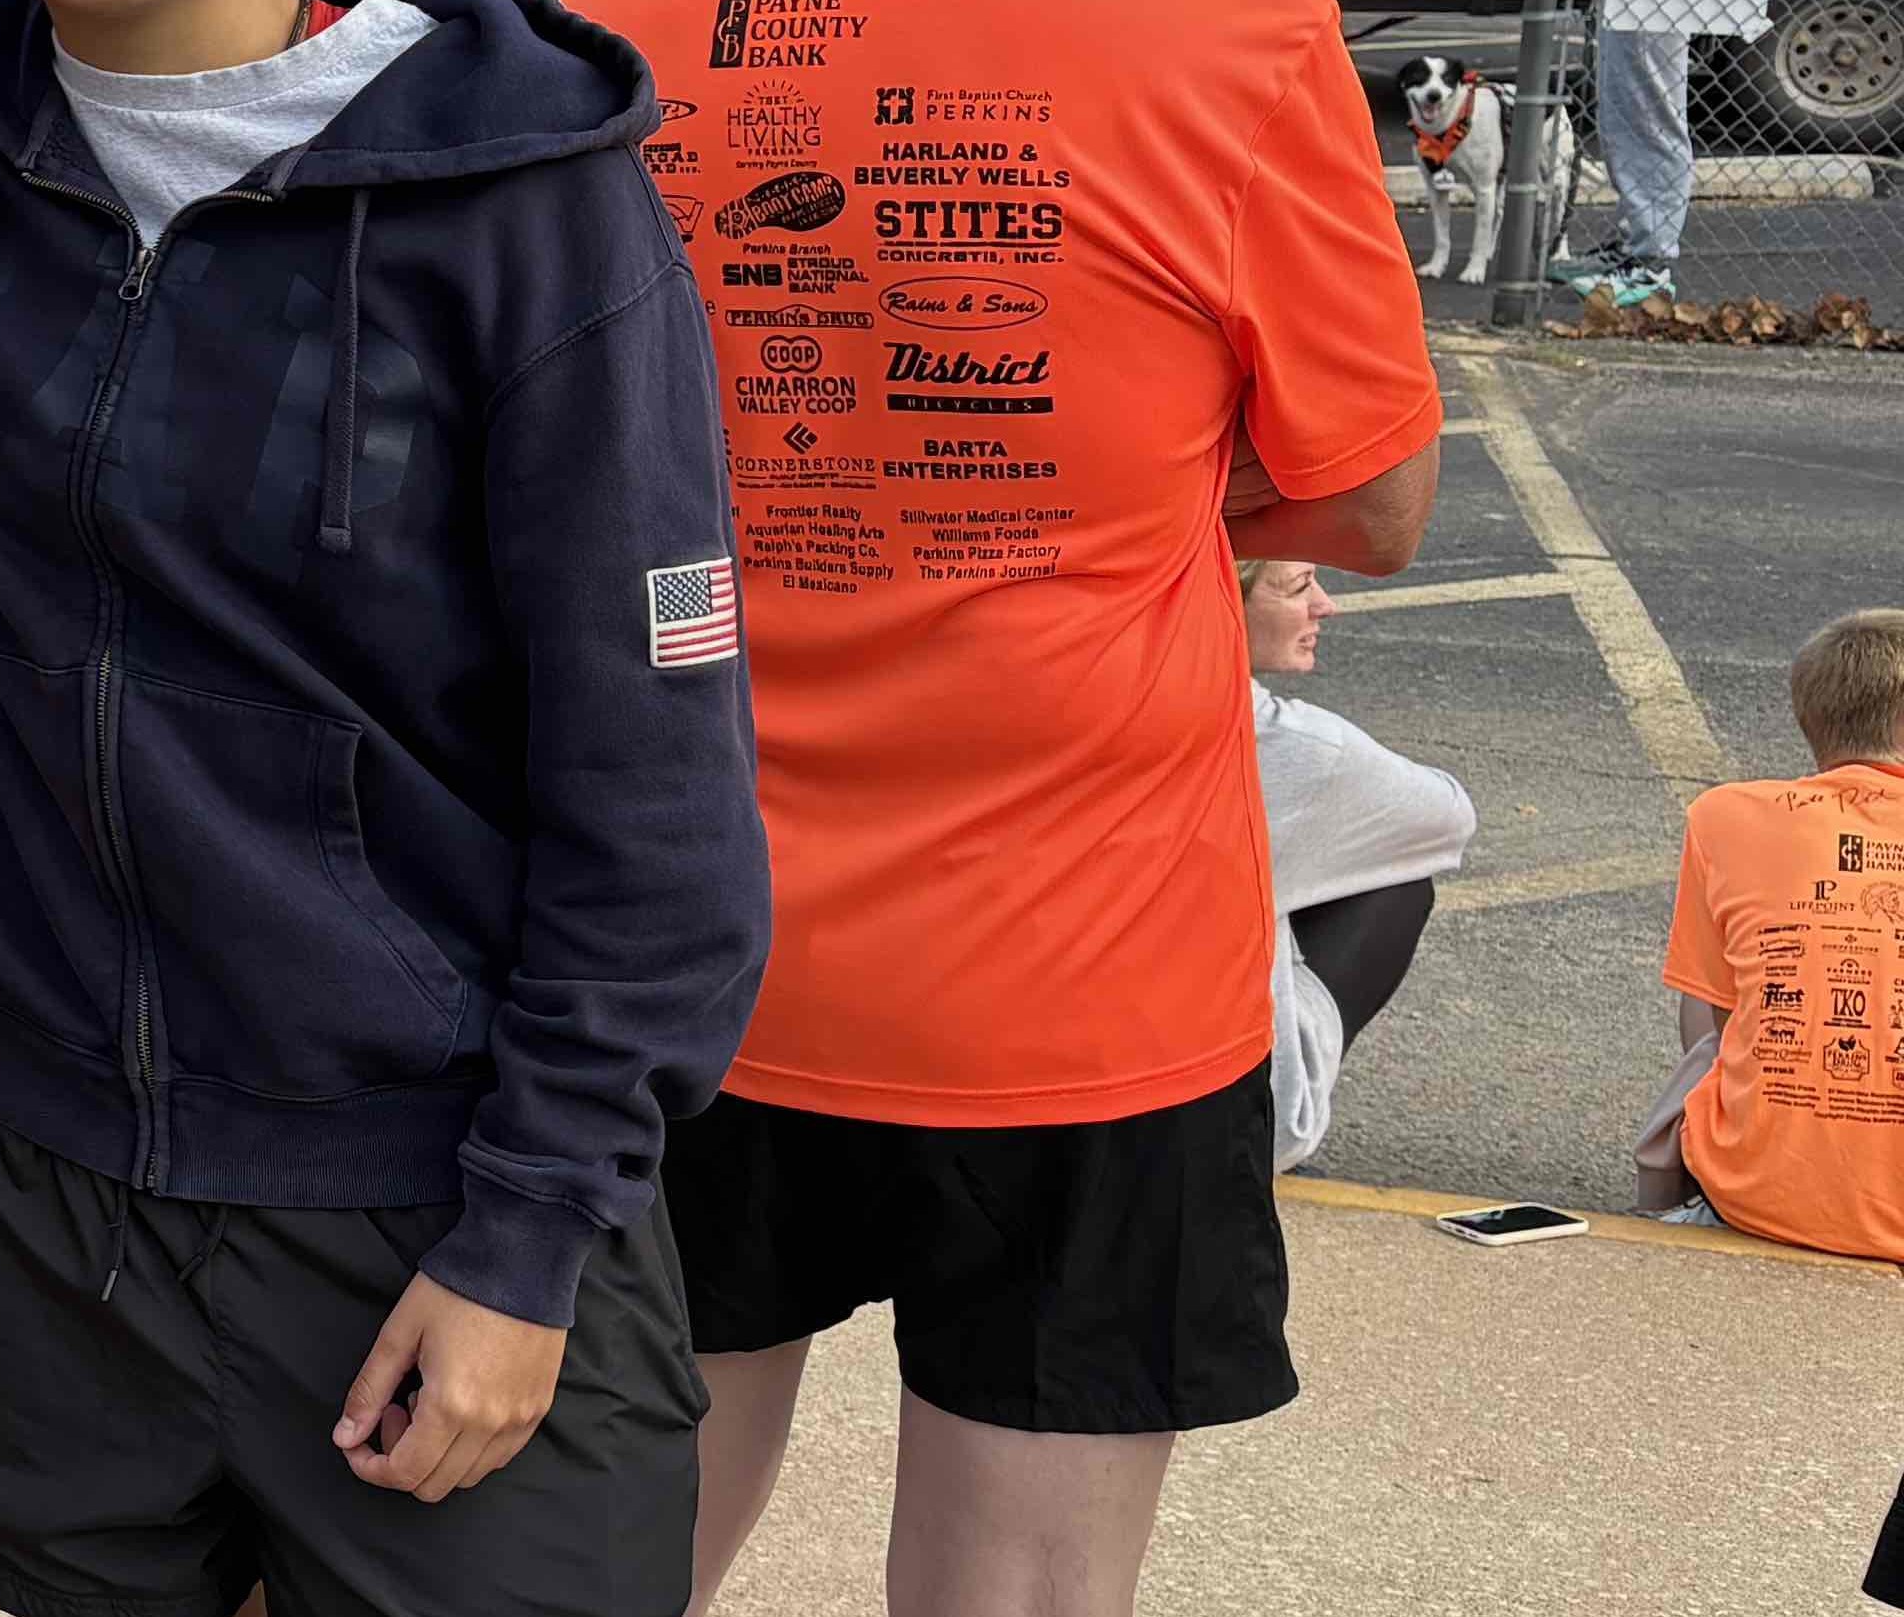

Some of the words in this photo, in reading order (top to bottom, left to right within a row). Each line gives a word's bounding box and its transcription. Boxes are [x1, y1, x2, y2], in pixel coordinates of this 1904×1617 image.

[750, 16, 868, 41] COUNTY
[748, 44, 828, 68] BANK
[926, 90, 954, 101] First
[958, 90, 1003, 103] Baptist
[1006, 90, 1053, 102] Church
[727, 106, 822, 126] HEALTHY
[926, 104, 1052, 122] PERKINS
[727, 127, 822, 148] LIVING
[882, 142, 1009, 161] HARLAND
[1018, 144, 1039, 161] &
[854, 167, 970, 185] BEVERLY
[976, 168, 1072, 188] WELLS
[874, 199, 1062, 240] STITES
[787, 257, 856, 270] STROUD
[1014, 251, 1065, 263] INC.
[722, 263, 784, 287] SNB
[787, 270, 870, 283] NATIONAL
[789, 283, 837, 294] BANK
[956, 293, 973, 313] &
[982, 293, 1040, 313] Sons
[766, 345, 816, 364] COOP
[882, 341, 1051, 385] District
[735, 376, 857, 397] CIMARRON
[736, 397, 801, 415] VALLEY
[805, 397, 857, 415] COOP
[907, 399, 1033, 412] BICYCLES
[923, 439, 1008, 458] BARTA
[735, 456, 876, 472] CORNERSTONE
[882, 461, 1059, 480] ENTERPRISES
[1024, 508, 1075, 522] Center
[858, 524, 885, 539] Arts
[932, 528, 991, 542] Williams
[994, 527, 1039, 540] Foods
[858, 543, 881, 558] Co.
[913, 546, 965, 561] Perkins
[967, 546, 1004, 560] Pizza
[1007, 544, 1062, 561] Factory
[919, 564, 944, 580] The
[946, 565, 996, 580] Perkins
[1000, 562, 1057, 579] Journal
[1866, 840, 1904, 853] PAYN
[1830, 987, 1866, 1017] TKO
